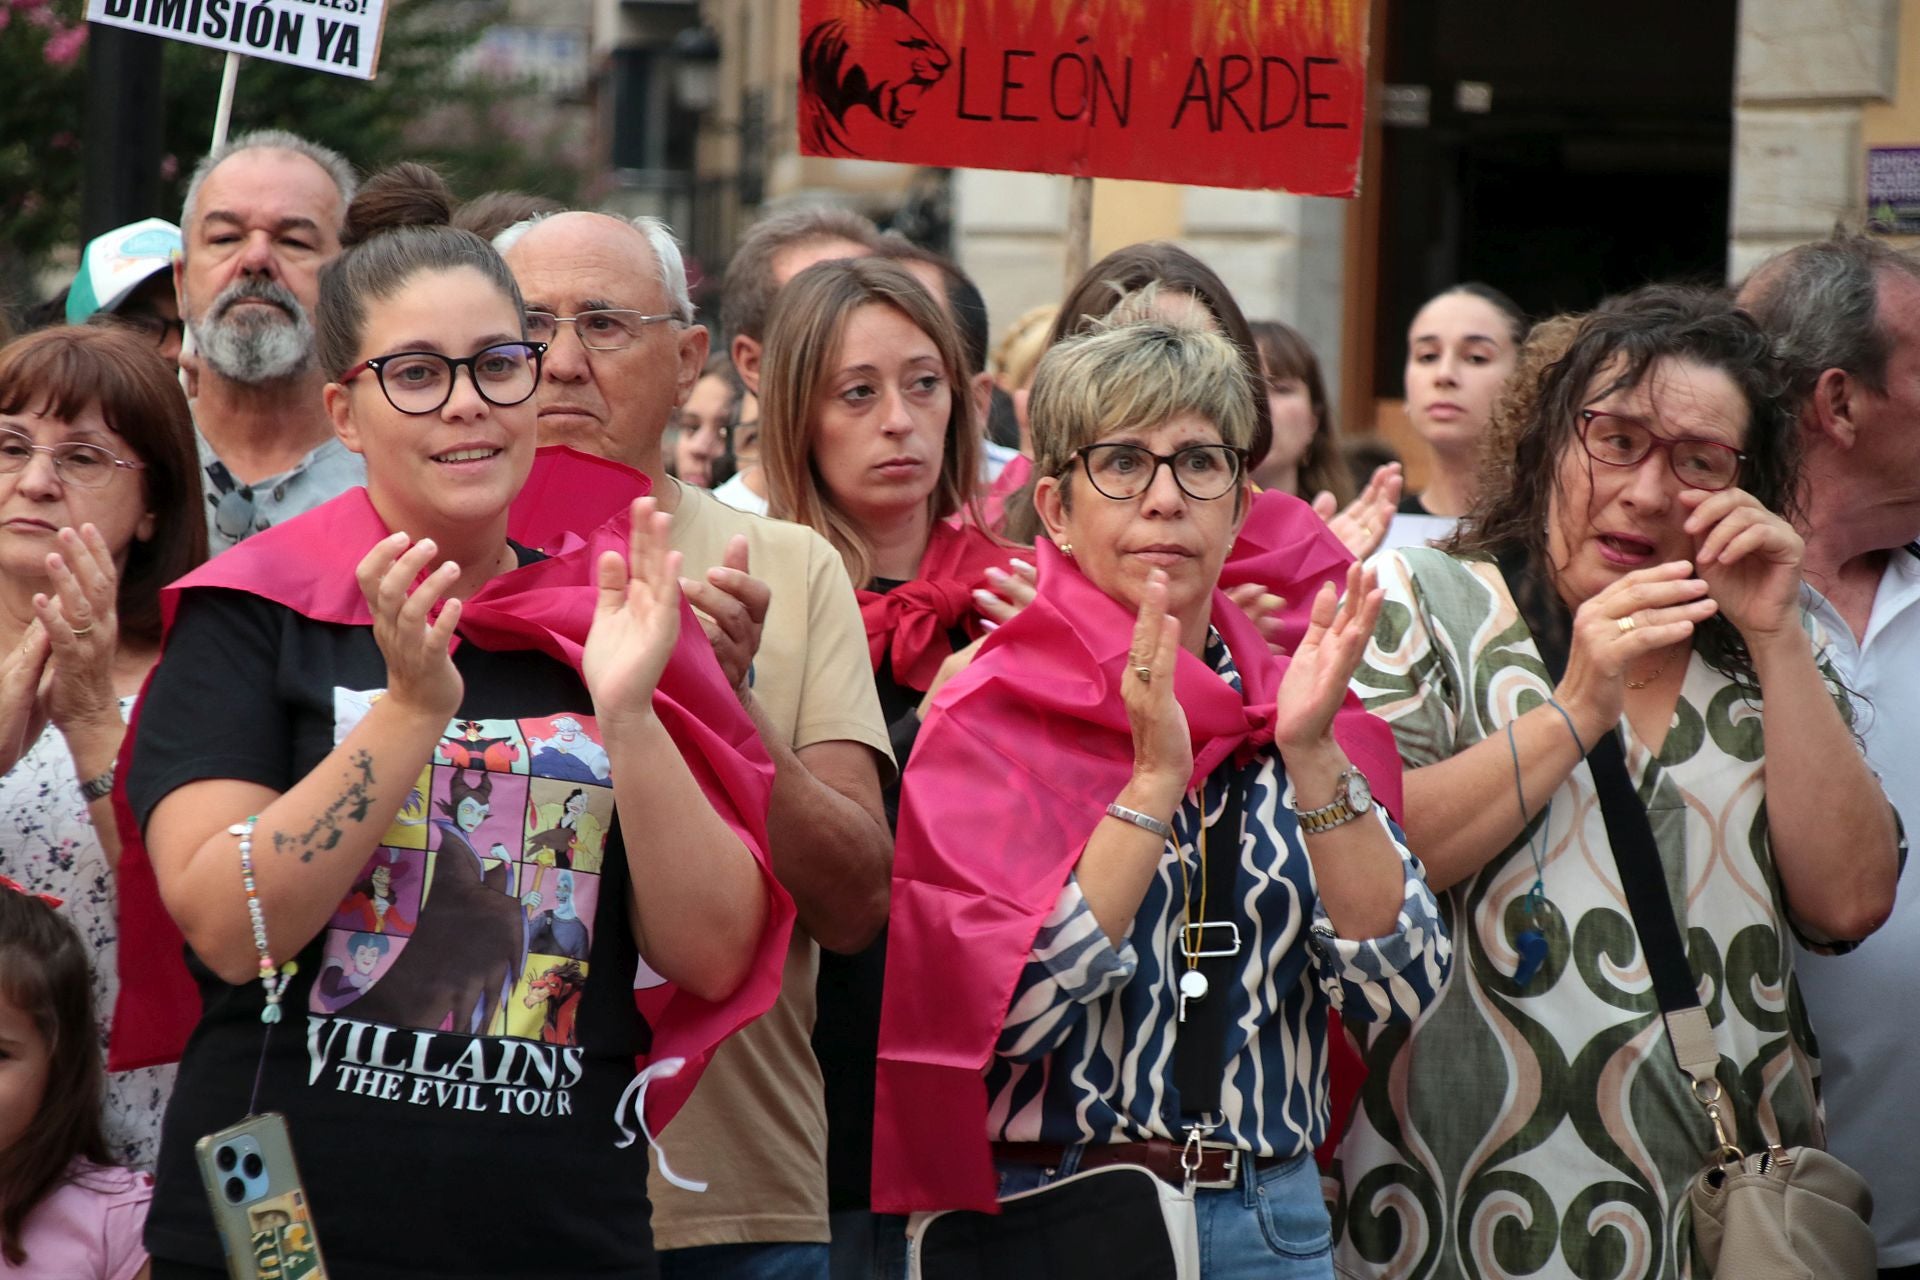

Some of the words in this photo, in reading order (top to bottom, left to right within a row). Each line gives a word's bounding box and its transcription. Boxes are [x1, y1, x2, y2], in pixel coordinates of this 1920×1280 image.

[316, 18, 360, 67] YA
[956, 36, 1132, 128] LEÓN
[1171, 54, 1349, 133] ARDE
[306, 1015, 585, 1088] VILLAINS
[336, 1064, 405, 1101] THE
[408, 1077, 487, 1112] EVIL
[495, 1087, 573, 1117] TOUR
